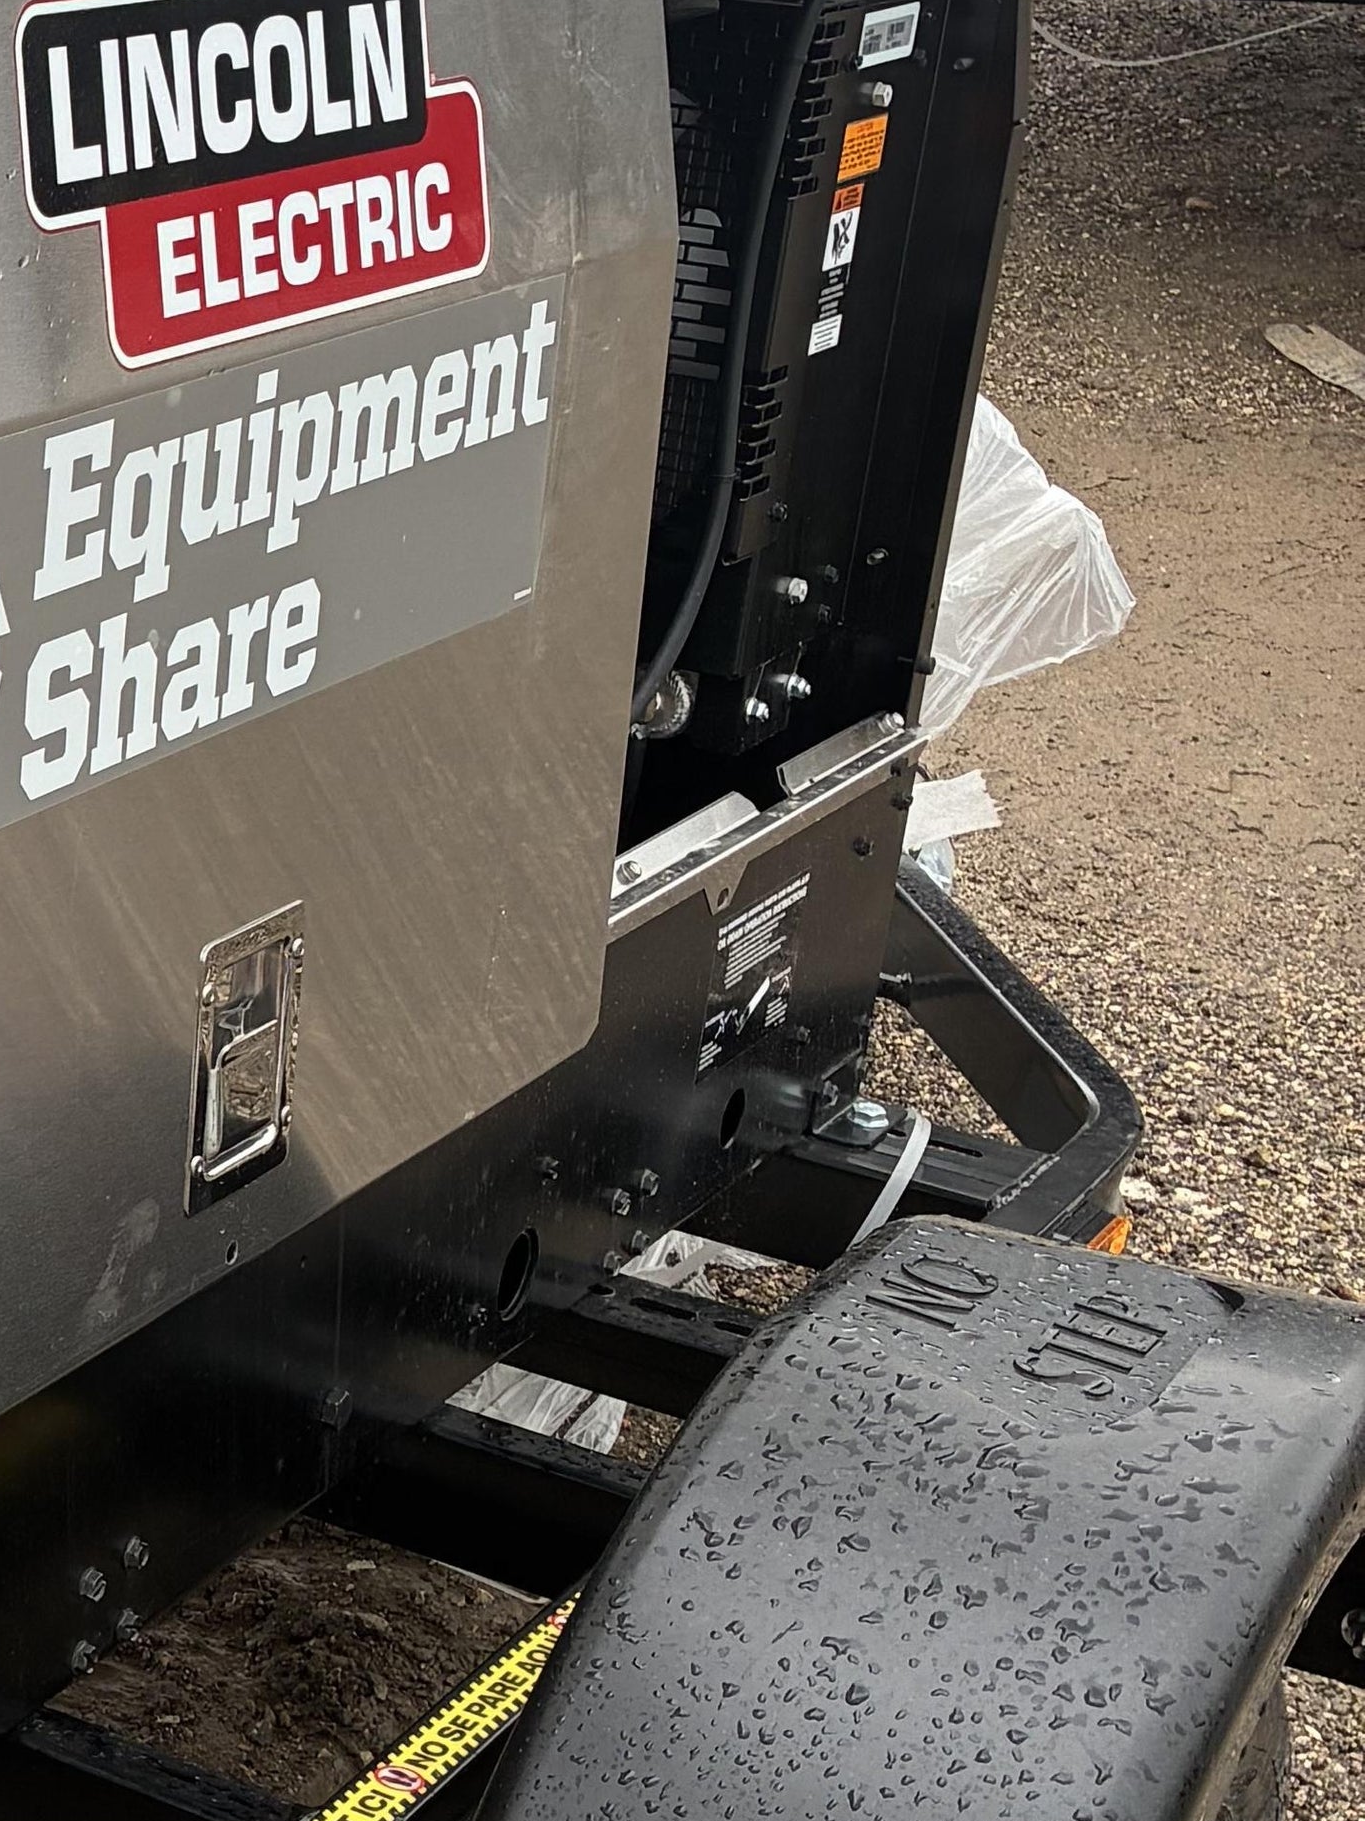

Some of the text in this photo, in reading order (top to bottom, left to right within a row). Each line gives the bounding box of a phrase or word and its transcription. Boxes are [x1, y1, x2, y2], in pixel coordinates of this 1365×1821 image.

[46, 0, 408, 185] LINCOLN
[156, 162, 453, 320] ELECTRIC
[34, 299, 558, 600] Equipment
[19, 578, 321, 803] Share
[865, 1254, 999, 1329] NO
[1013, 1293, 1168, 1399] STEP
[404, 1671, 529, 1771] NO SE PARE
[354, 1788, 395, 1821] ICI
